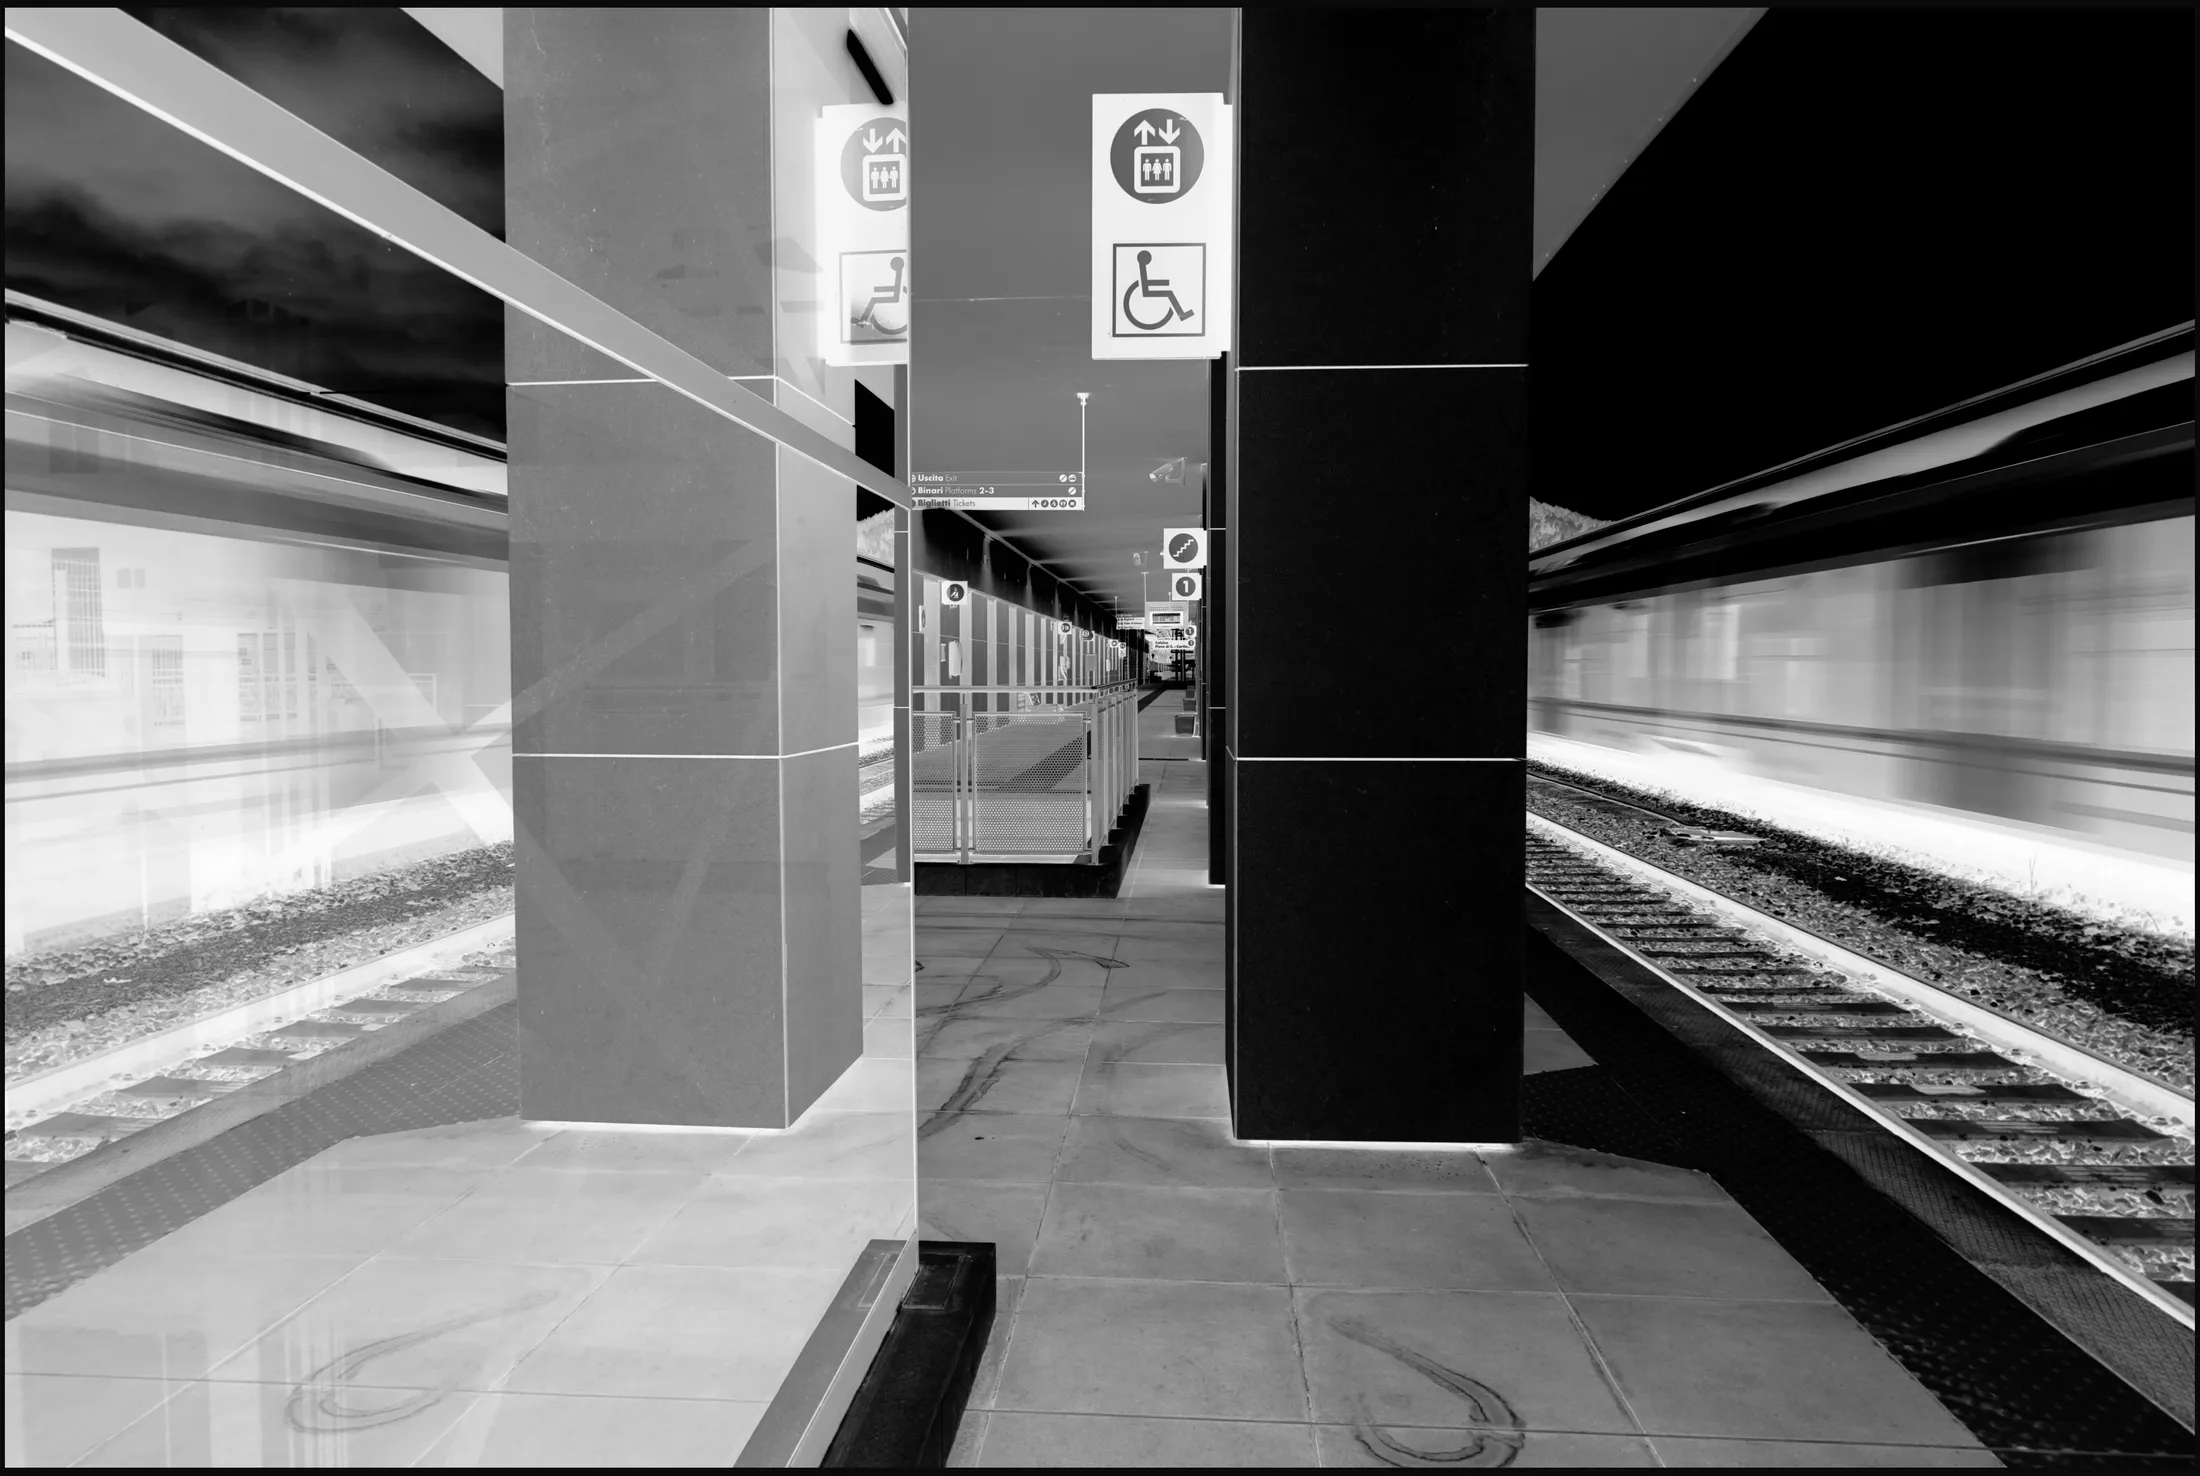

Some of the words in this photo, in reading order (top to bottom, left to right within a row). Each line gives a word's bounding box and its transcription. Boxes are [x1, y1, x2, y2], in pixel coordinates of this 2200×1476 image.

[918, 474, 944, 482] Uscita
[945, 474, 958, 482] Exit
[918, 499, 951, 508] Biglietti
[953, 499, 976, 507] Tickets
[1183, 580, 1189, 593] 1
